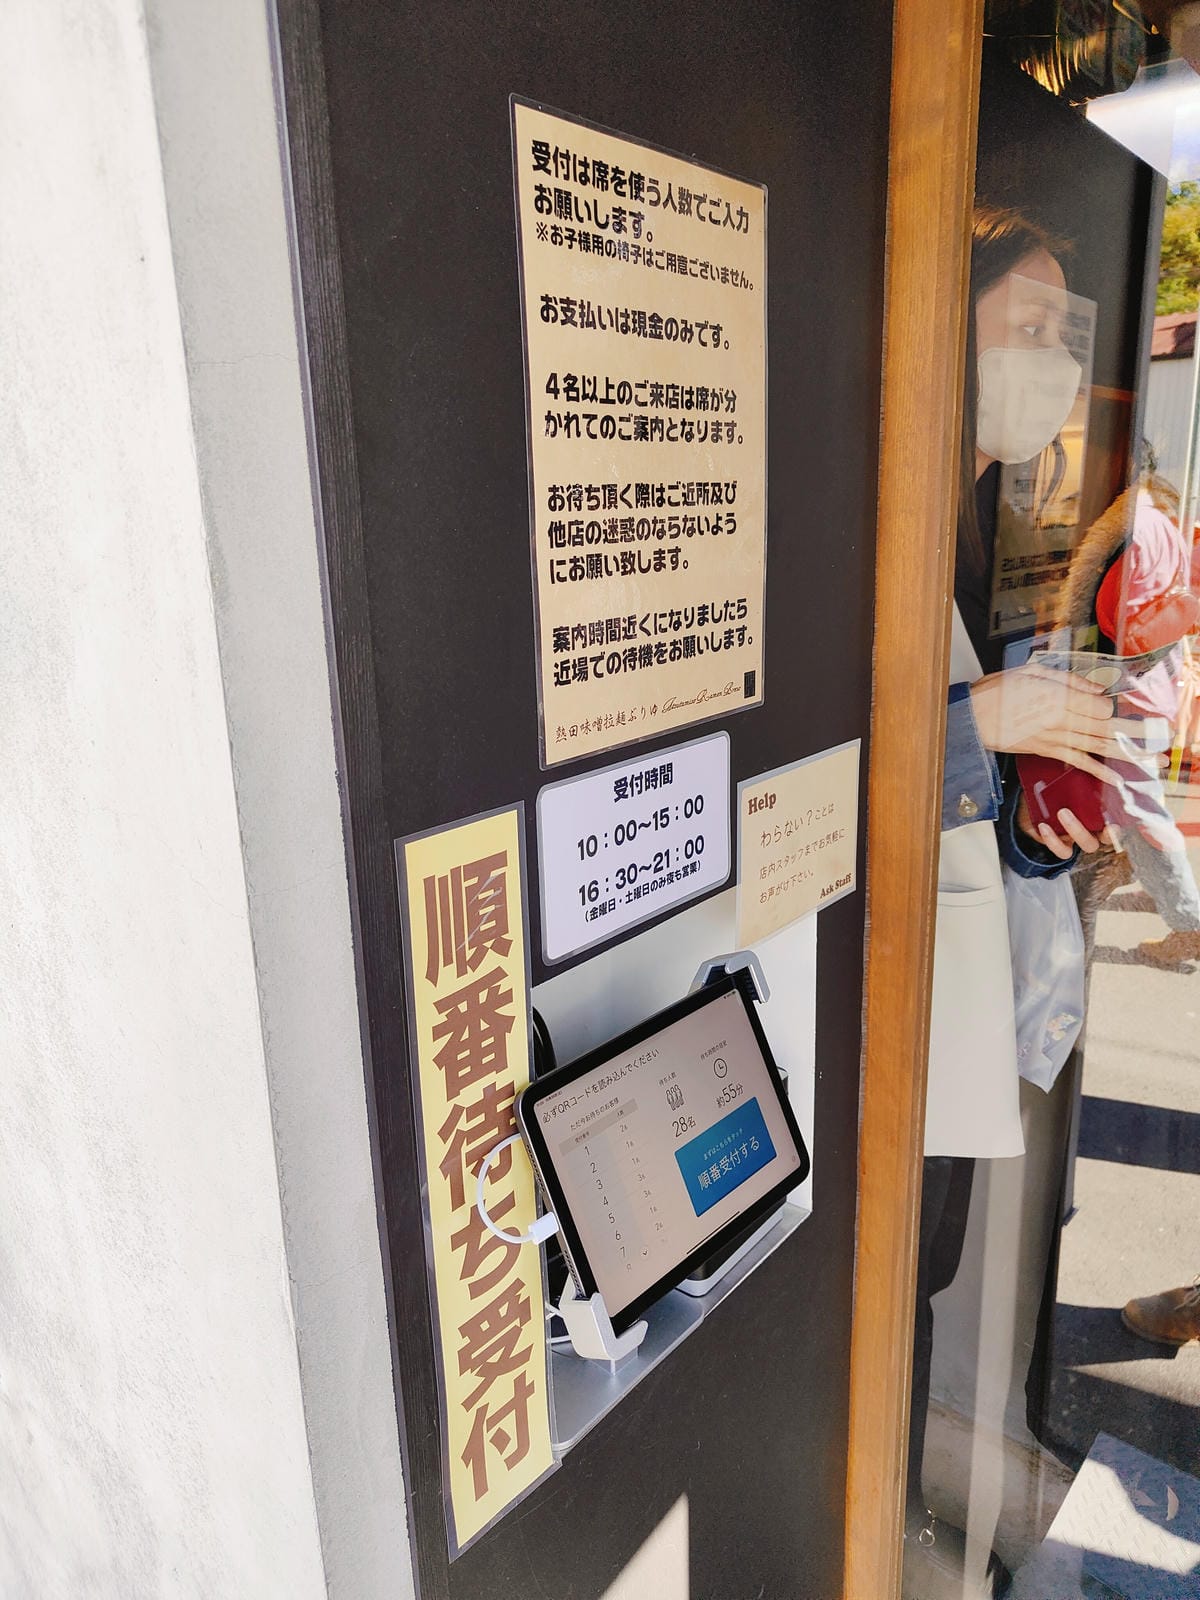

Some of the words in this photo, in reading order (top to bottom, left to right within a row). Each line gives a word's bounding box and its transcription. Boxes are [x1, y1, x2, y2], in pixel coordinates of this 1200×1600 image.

[531, 139, 749, 234] 受付は席を使う人数でご入力
[534, 183, 653, 243] お願いします。
[536, 221, 754, 291] ※お子様用の椅子はご用意ございません。
[540, 293, 730, 350] お支払いは現金のみです。
[545, 372, 737, 413] 4名以上のご来店は席が分
[544, 410, 743, 445] かれてのご案内となります。
[547, 480, 738, 512] お待ち頂く際はご近所及び
[547, 512, 737, 549] 他店の迷惑のならないよう
[550, 546, 689, 584] にお願い致します。
[552, 598, 748, 653] 案内時間近くになりましたら
[553, 624, 753, 687] 近場での待機をお願いします。
[613, 762, 674, 803] 受付時間
[747, 791, 777, 816] Help
[819, 884, 834, 899] Ask
[834, 872, 852, 891] Staff
[542, 1048, 660, 1124] 必ずQRコードを読み込んでください
[671, 1115, 696, 1138] 28名
[584, 1145, 590, 1156] 1
[590, 1162, 598, 1174] 2
[698, 1135, 760, 1191] 順番受付する
[422, 849, 537, 1503] 順番待ち受付
[596, 1179, 603, 1190] 3
[602, 1196, 609, 1206] 4
[608, 1213, 616, 1224] 5
[615, 1230, 622, 1241] 6
[619, 1246, 626, 1258] 7
